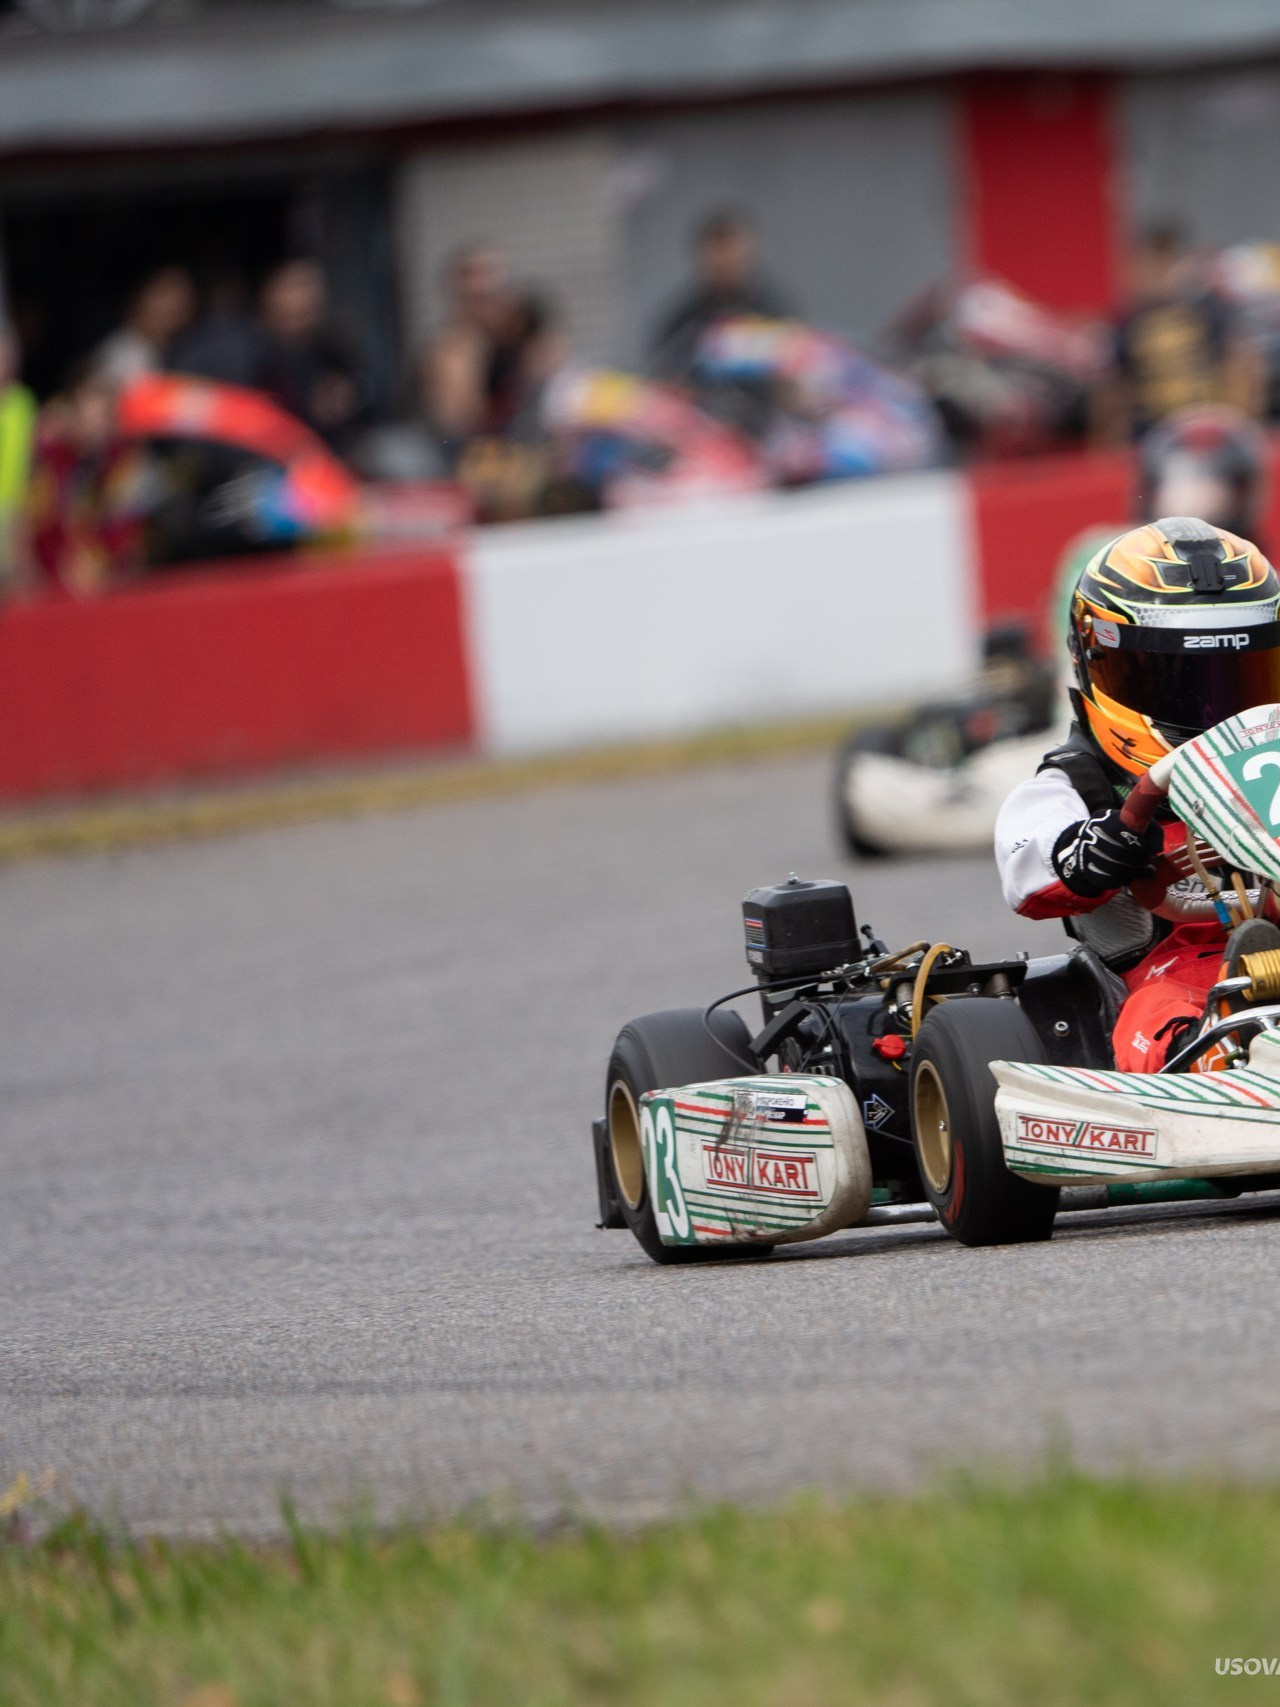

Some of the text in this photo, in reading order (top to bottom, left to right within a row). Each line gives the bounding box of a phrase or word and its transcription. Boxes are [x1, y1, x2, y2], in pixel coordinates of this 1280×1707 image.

[1183, 633, 1250, 650] zamp
[1018, 1116, 1155, 1151] TONY KART
[640, 1106, 689, 1238] 23
[703, 1145, 814, 1189] TONY KART
